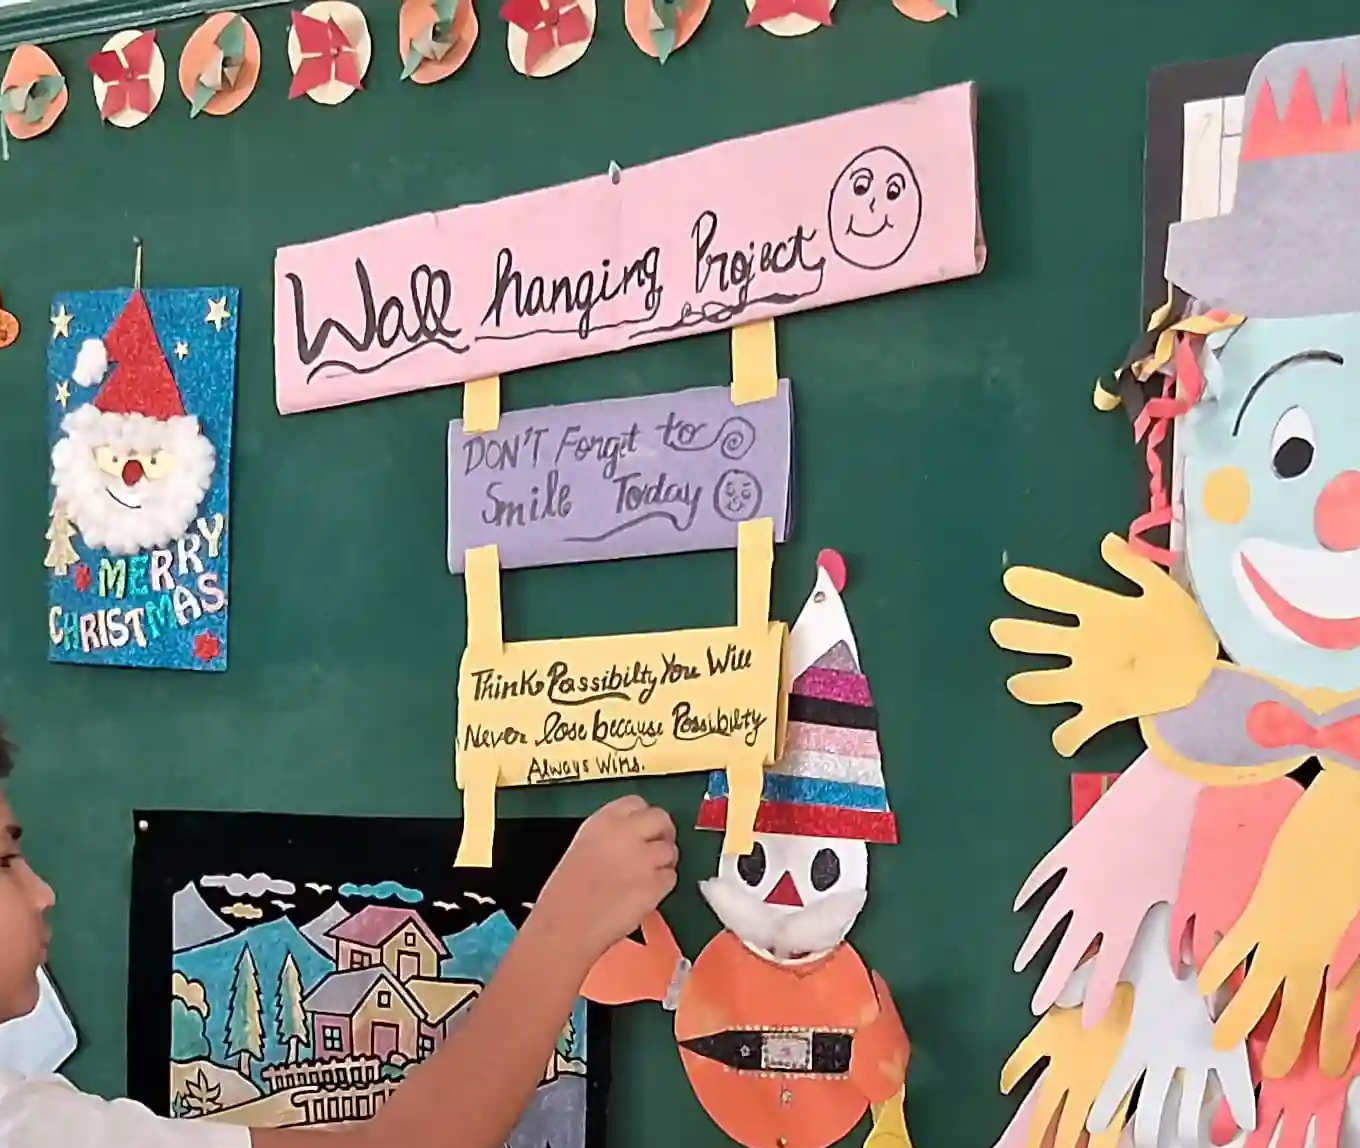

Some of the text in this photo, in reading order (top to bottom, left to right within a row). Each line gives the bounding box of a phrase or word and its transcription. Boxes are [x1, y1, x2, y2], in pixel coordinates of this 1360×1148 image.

[287, 210, 824, 366] Wall hanging Project
[463, 426, 549, 475] DON'T
[482, 470, 703, 532] Smile Today
[99, 513, 224, 599] MERRY
[49, 573, 226, 652] CHRISTMAS
[659, 652, 701, 685] You
[706, 643, 752, 677] Will
[592, 709, 664, 746] because
[528, 757, 589, 783] Always
